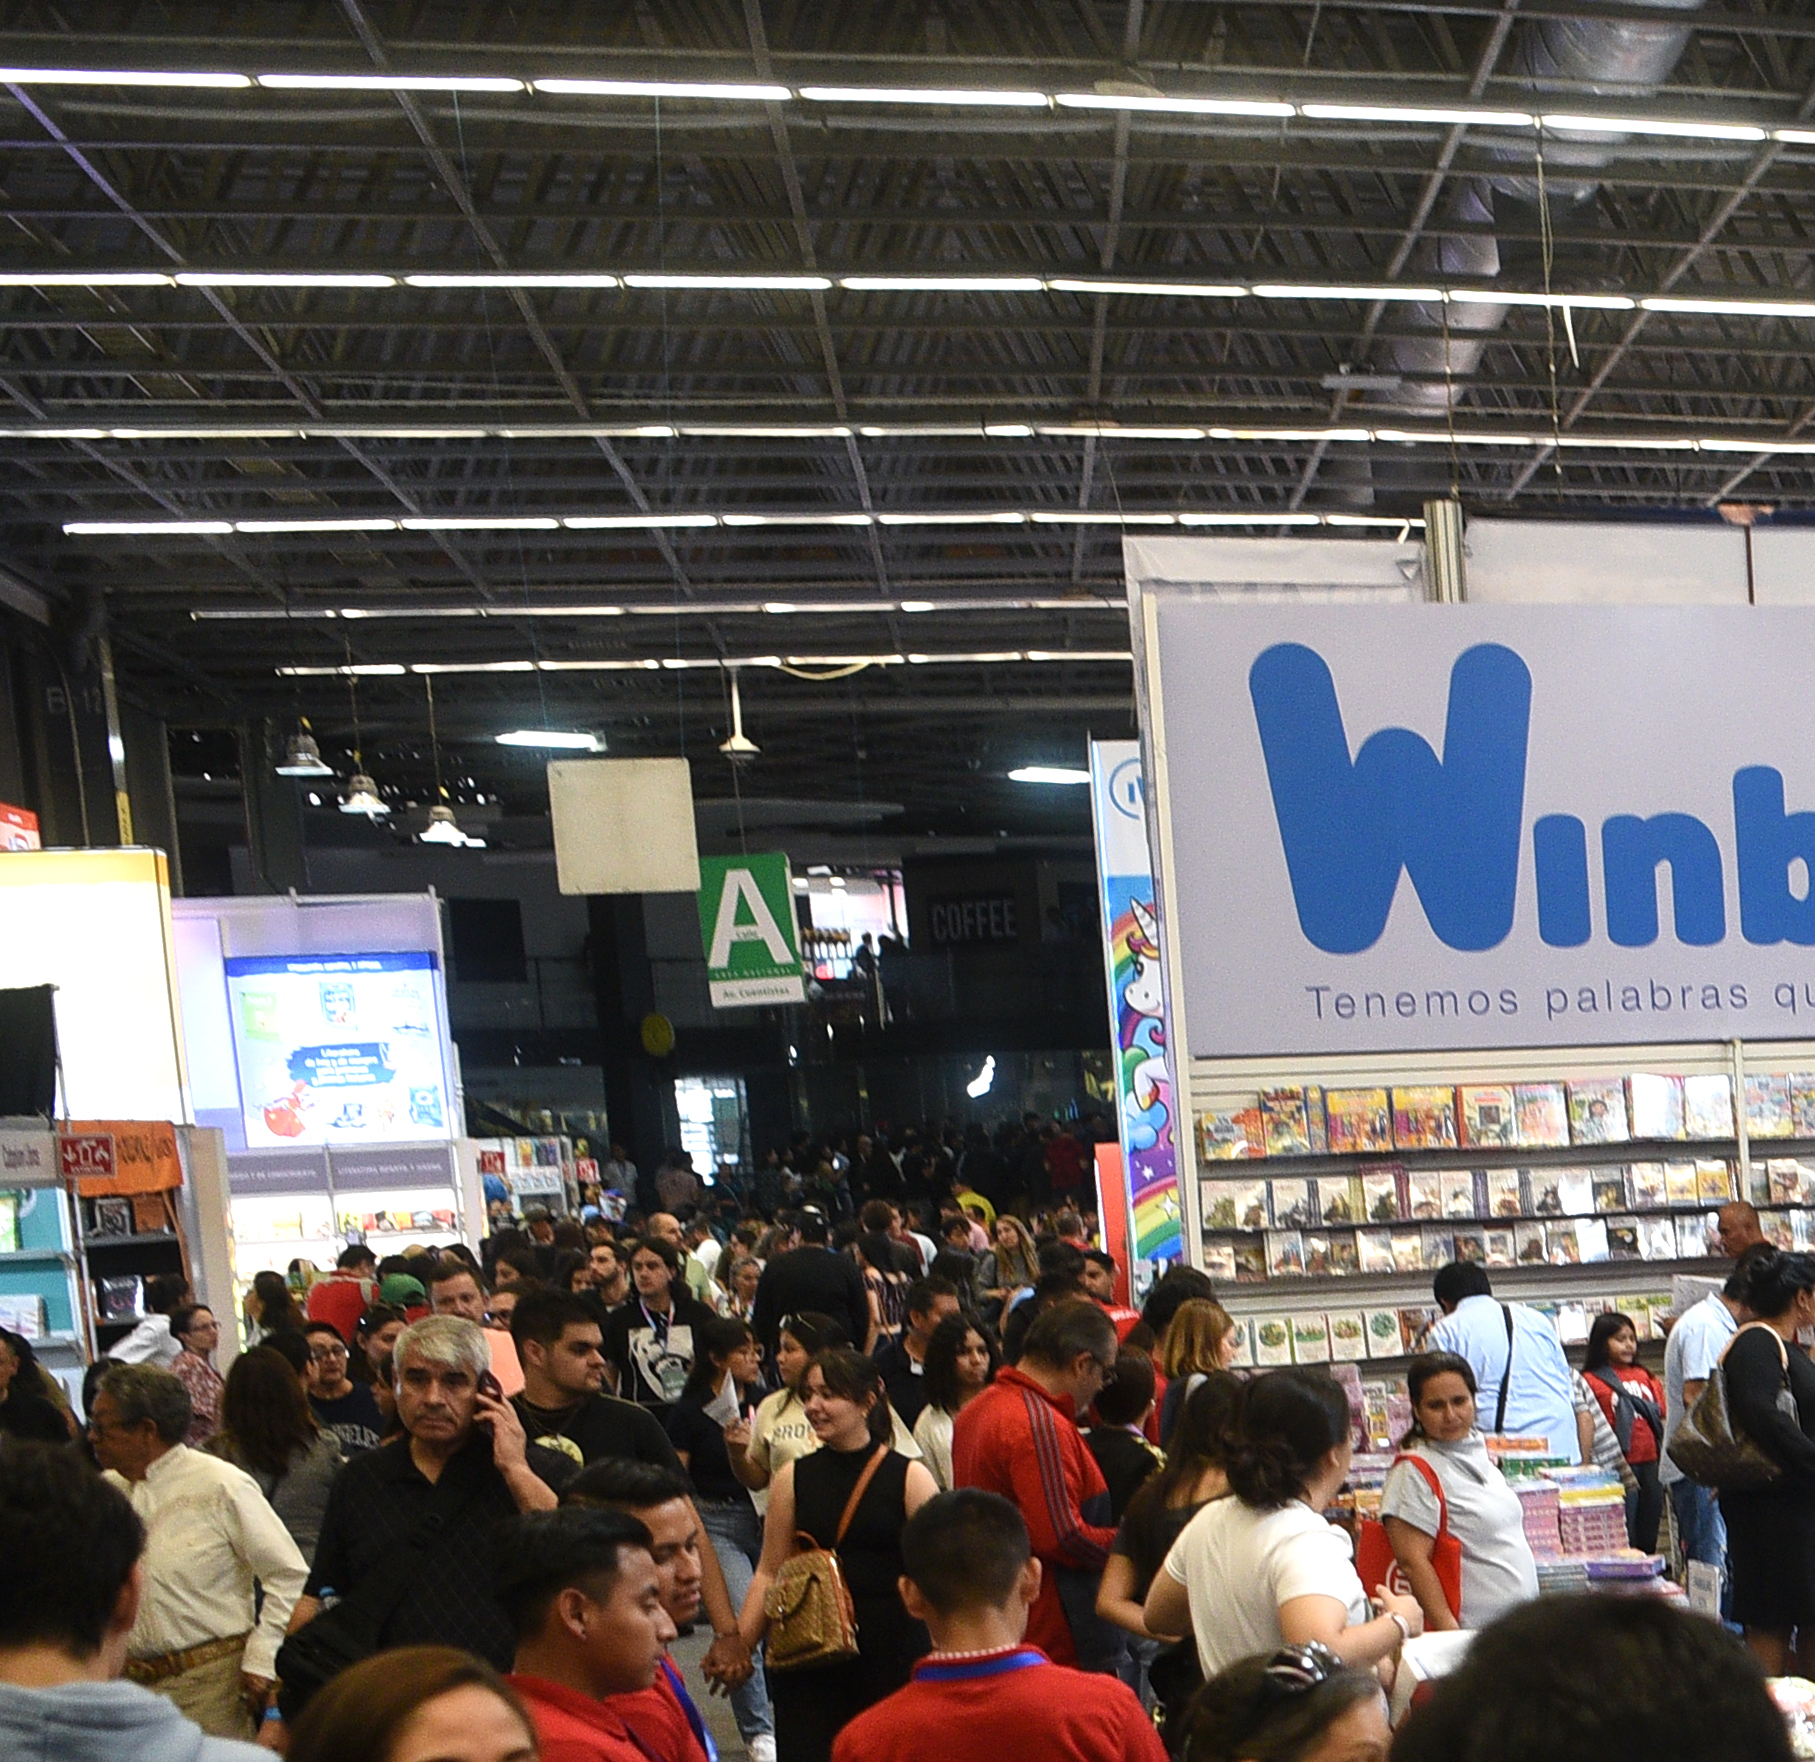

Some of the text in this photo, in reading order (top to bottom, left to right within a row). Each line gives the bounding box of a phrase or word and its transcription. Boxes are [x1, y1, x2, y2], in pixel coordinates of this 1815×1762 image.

[708, 869, 795, 969] A
[932, 901, 1017, 941] COFFEE
[1305, 985, 1520, 1021] Tenemos
[1546, 976, 1749, 1019] palabras
